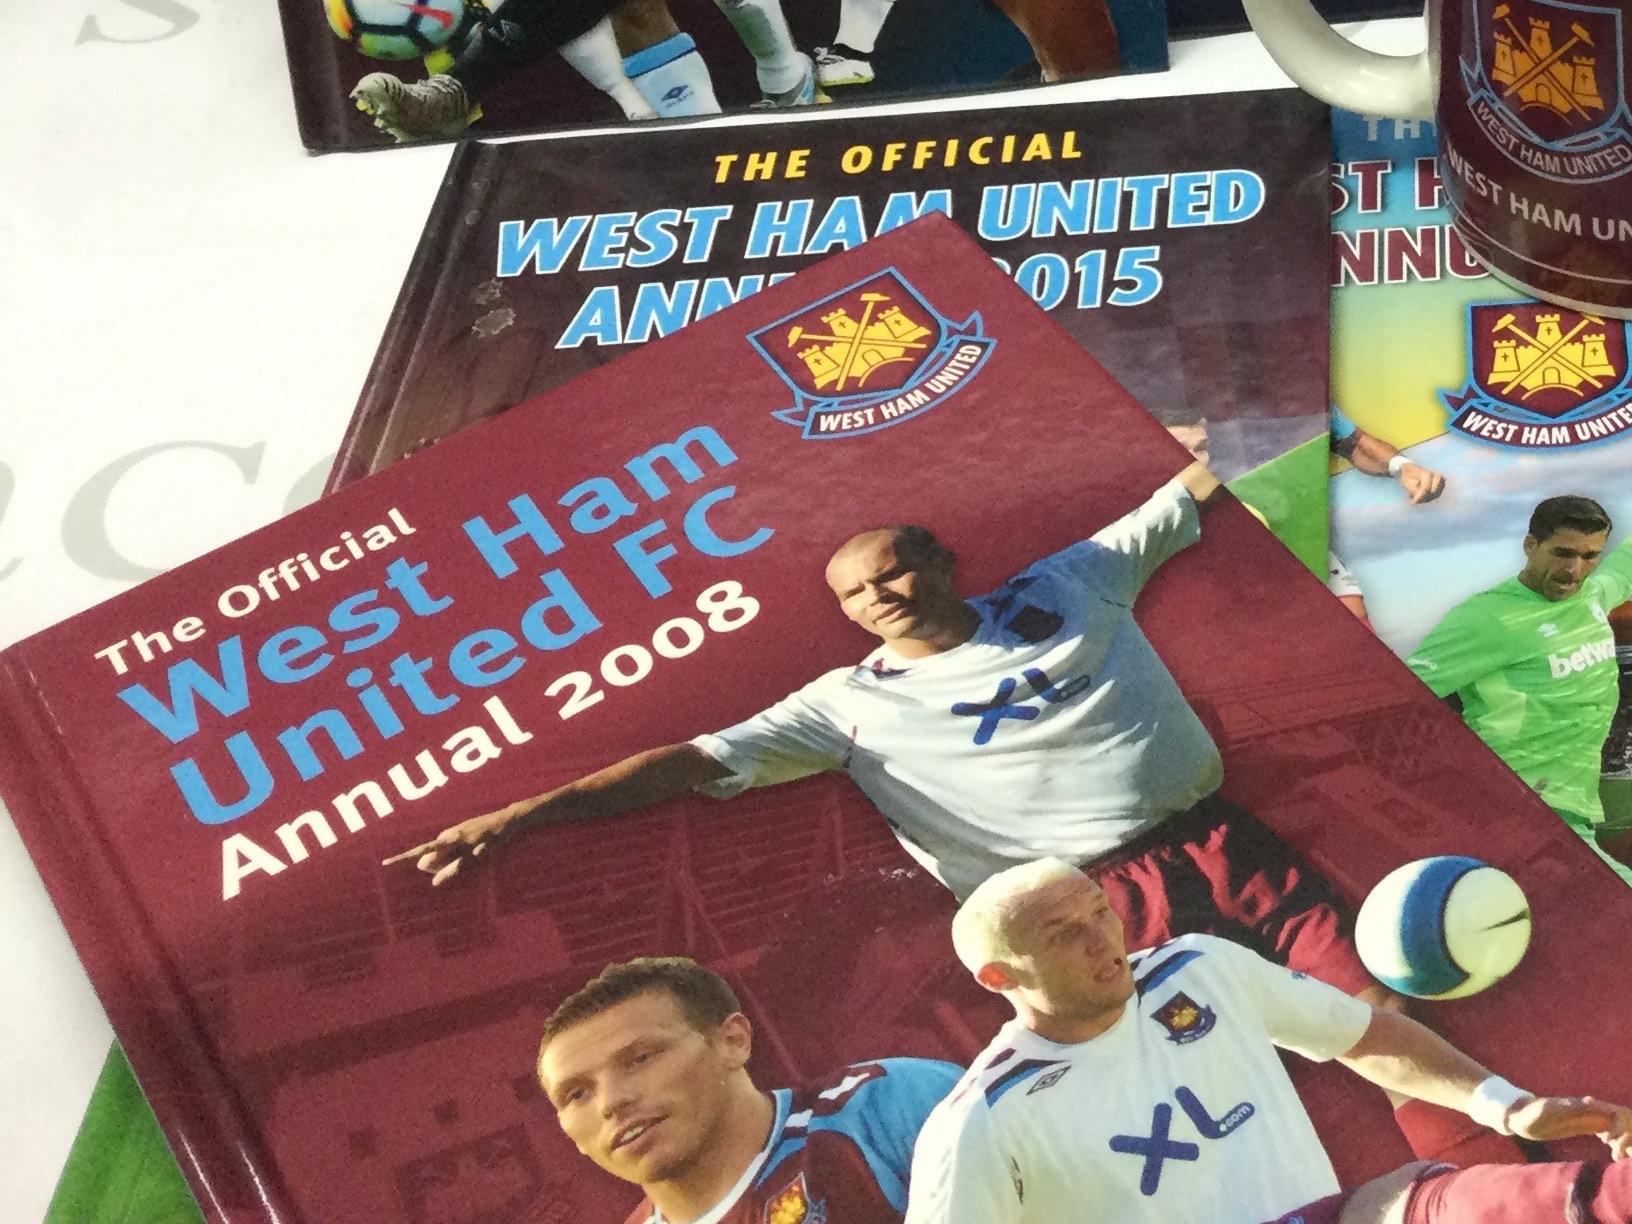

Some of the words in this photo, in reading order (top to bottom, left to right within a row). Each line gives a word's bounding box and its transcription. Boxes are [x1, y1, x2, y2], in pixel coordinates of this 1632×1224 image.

[714, 147, 812, 185] THE
[842, 130, 1083, 173] OFFICIAL
[1443, 138, 1503, 206] WEST
[1509, 191, 1582, 237] HAM
[1476, 103, 1518, 160] WEST
[1520, 145, 1561, 175] HAM
[1566, 145, 1632, 176] UNITED
[496, 205, 730, 279] WEST
[977, 168, 1266, 239] UNITED
[818, 408, 876, 433] WEST
[882, 388, 930, 417] HAM
[927, 343, 982, 397] UNITED
[1462, 411, 1518, 444] WEST
[1522, 425, 1571, 445] HAM
[94, 616, 206, 676] The
[220, 507, 416, 618] Official
[117, 557, 452, 743] West
[463, 423, 738, 579] Ham
[169, 578, 603, 827] United
[613, 484, 775, 599] FC
[222, 699, 533, 901] Annual
[545, 579, 762, 720] 2008
[1109, 1085, 1255, 1196] XL
